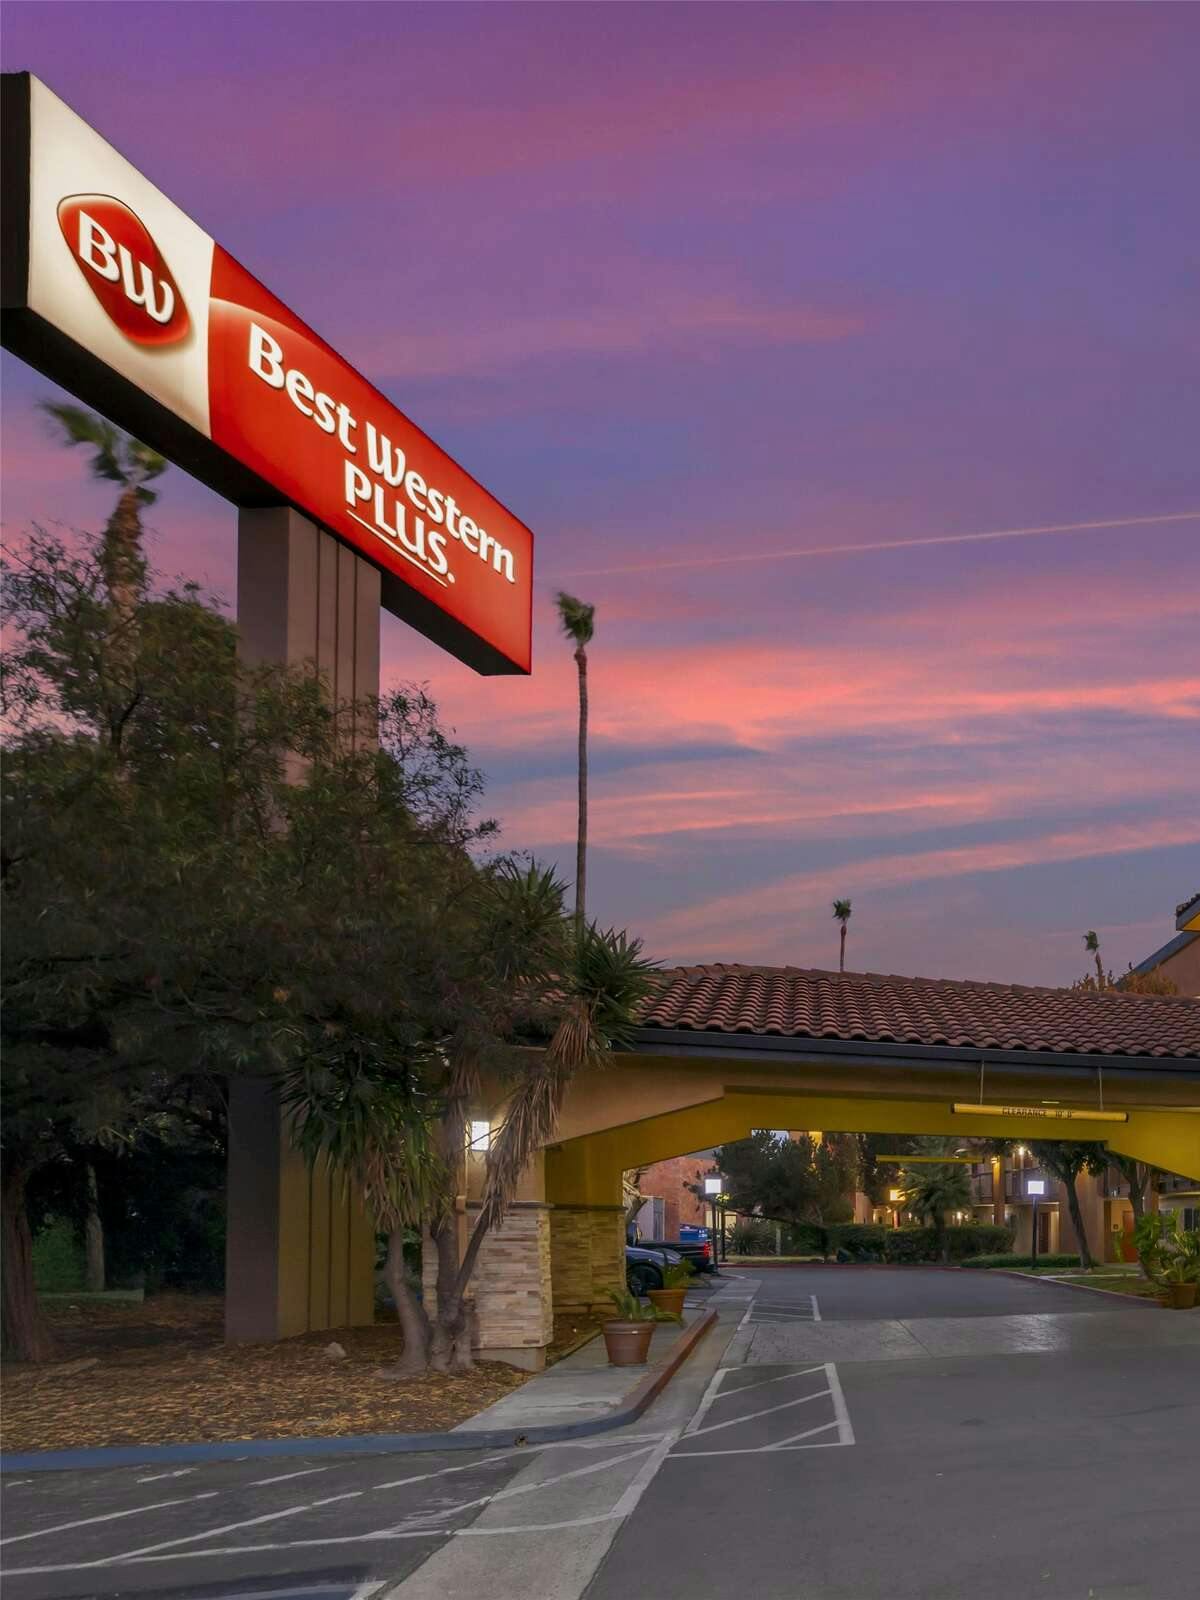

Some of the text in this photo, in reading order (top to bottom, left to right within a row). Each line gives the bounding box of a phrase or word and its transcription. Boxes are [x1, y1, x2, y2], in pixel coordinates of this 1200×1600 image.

[79, 210, 174, 323] BW
[248, 322, 516, 583] Best Western
